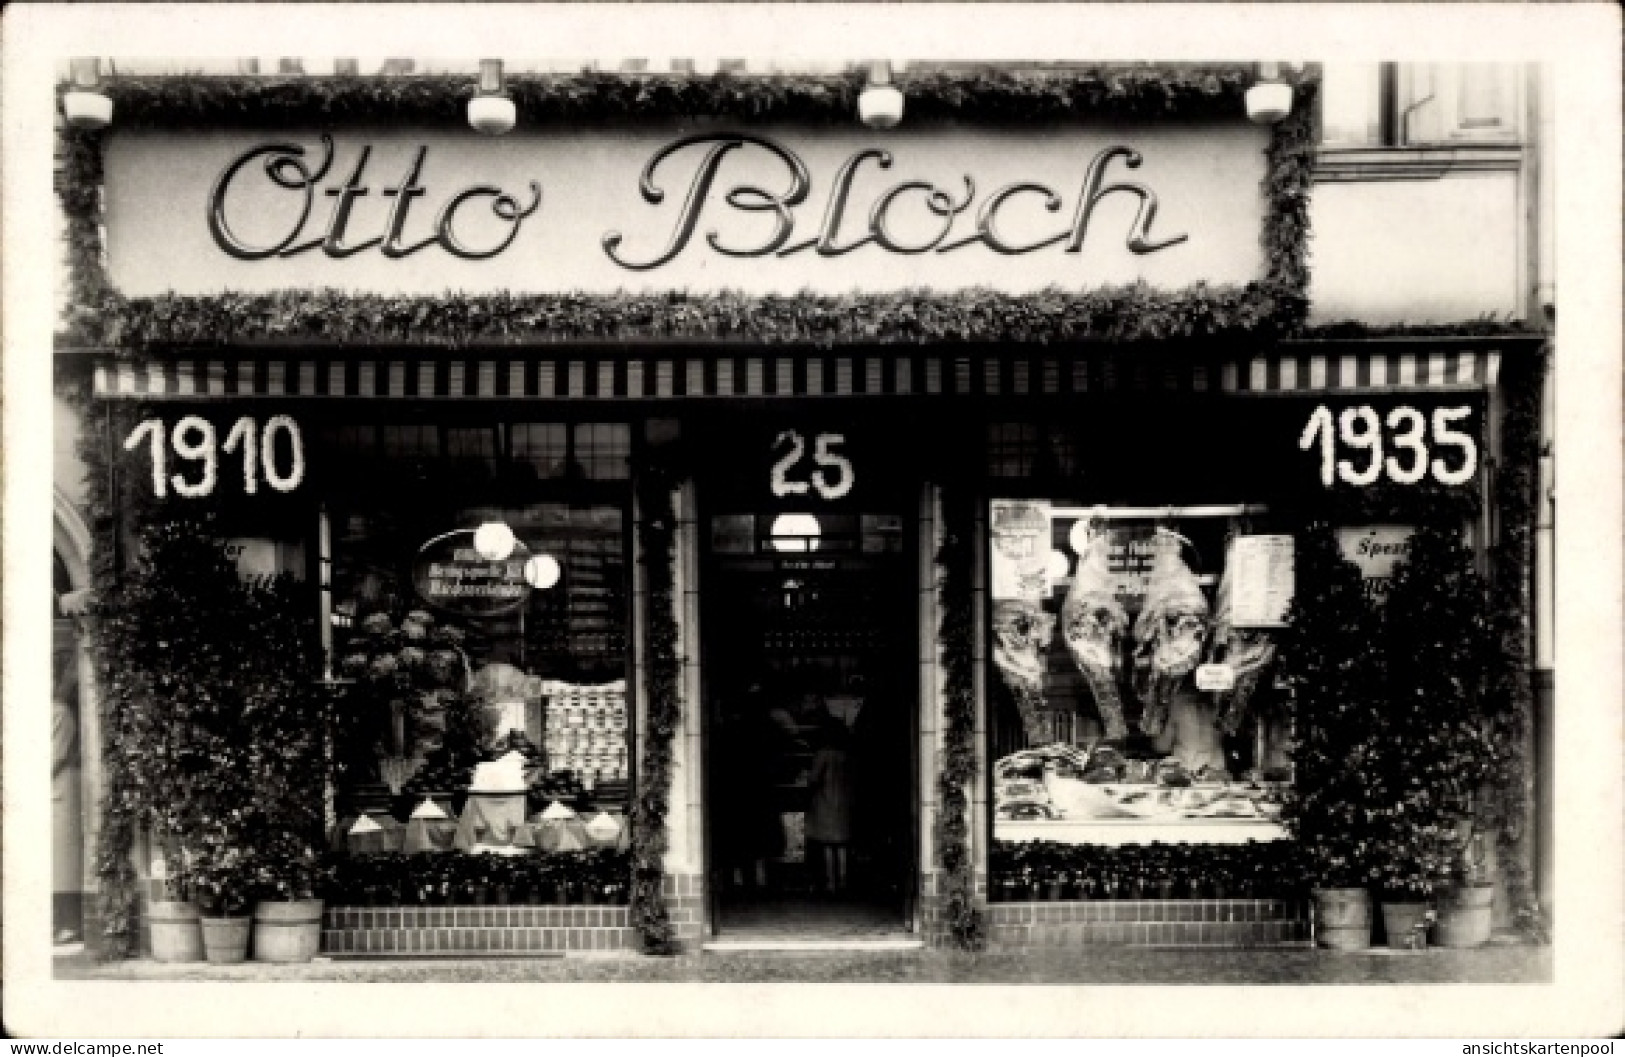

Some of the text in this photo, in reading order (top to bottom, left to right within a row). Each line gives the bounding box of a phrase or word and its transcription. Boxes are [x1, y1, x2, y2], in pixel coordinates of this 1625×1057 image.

[207, 132, 1188, 270] Otto Bloch
[123, 415, 306, 498] 1910
[770, 429, 855, 500] 25
[1299, 404, 1478, 487] 1935
